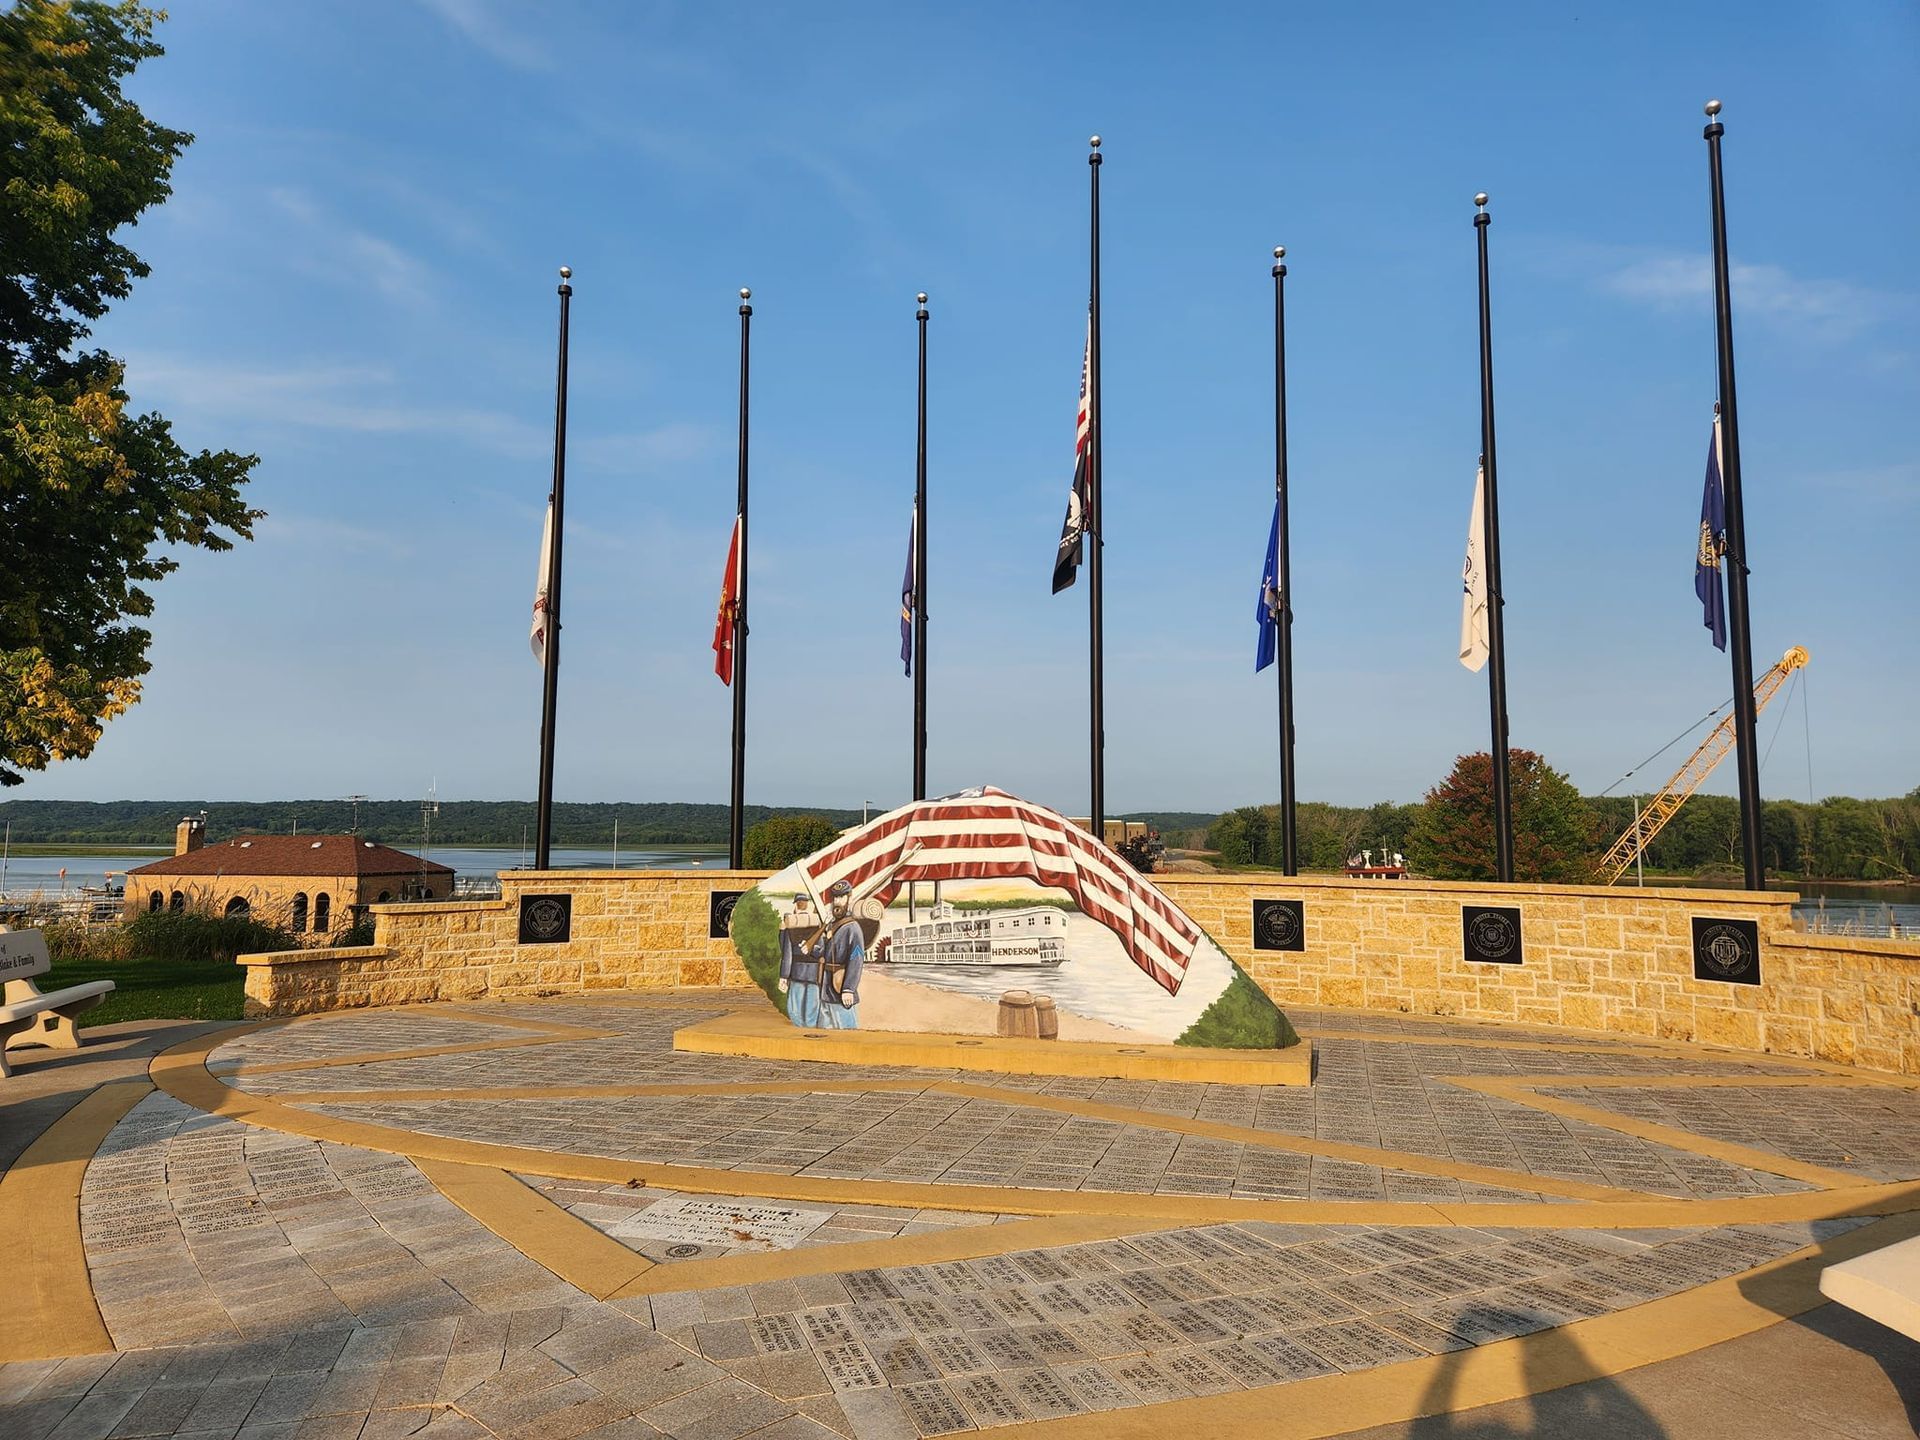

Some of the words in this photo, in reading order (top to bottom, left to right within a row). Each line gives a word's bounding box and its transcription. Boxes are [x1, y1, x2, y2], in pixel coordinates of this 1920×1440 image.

[992, 947, 1039, 956] HENDERSON
[18, 954, 34, 967] Family
[684, 1201, 741, 1212] Jackson
[752, 1214, 791, 1223] Rock
